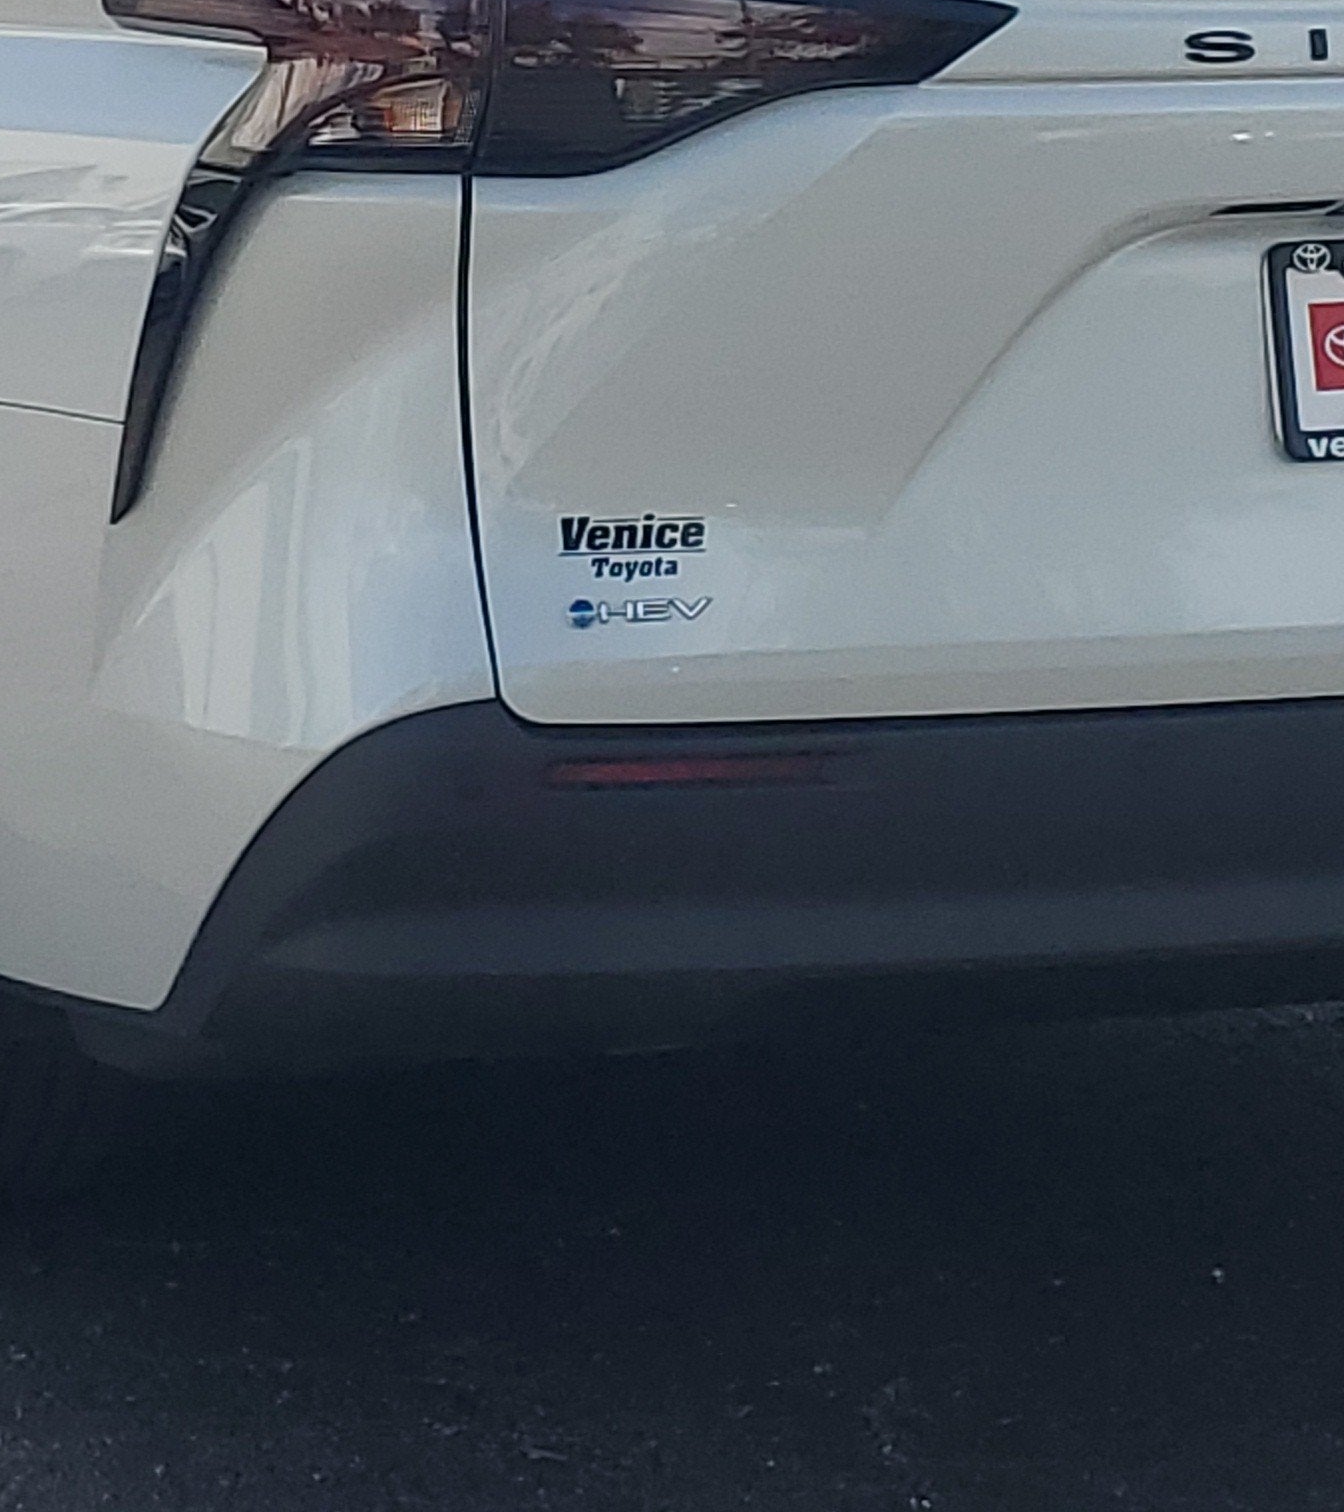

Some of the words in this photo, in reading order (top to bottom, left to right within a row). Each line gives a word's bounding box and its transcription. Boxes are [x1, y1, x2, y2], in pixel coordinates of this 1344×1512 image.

[560, 514, 706, 551] Venice
[591, 557, 678, 582] Toyota
[598, 596, 713, 624] HEV
